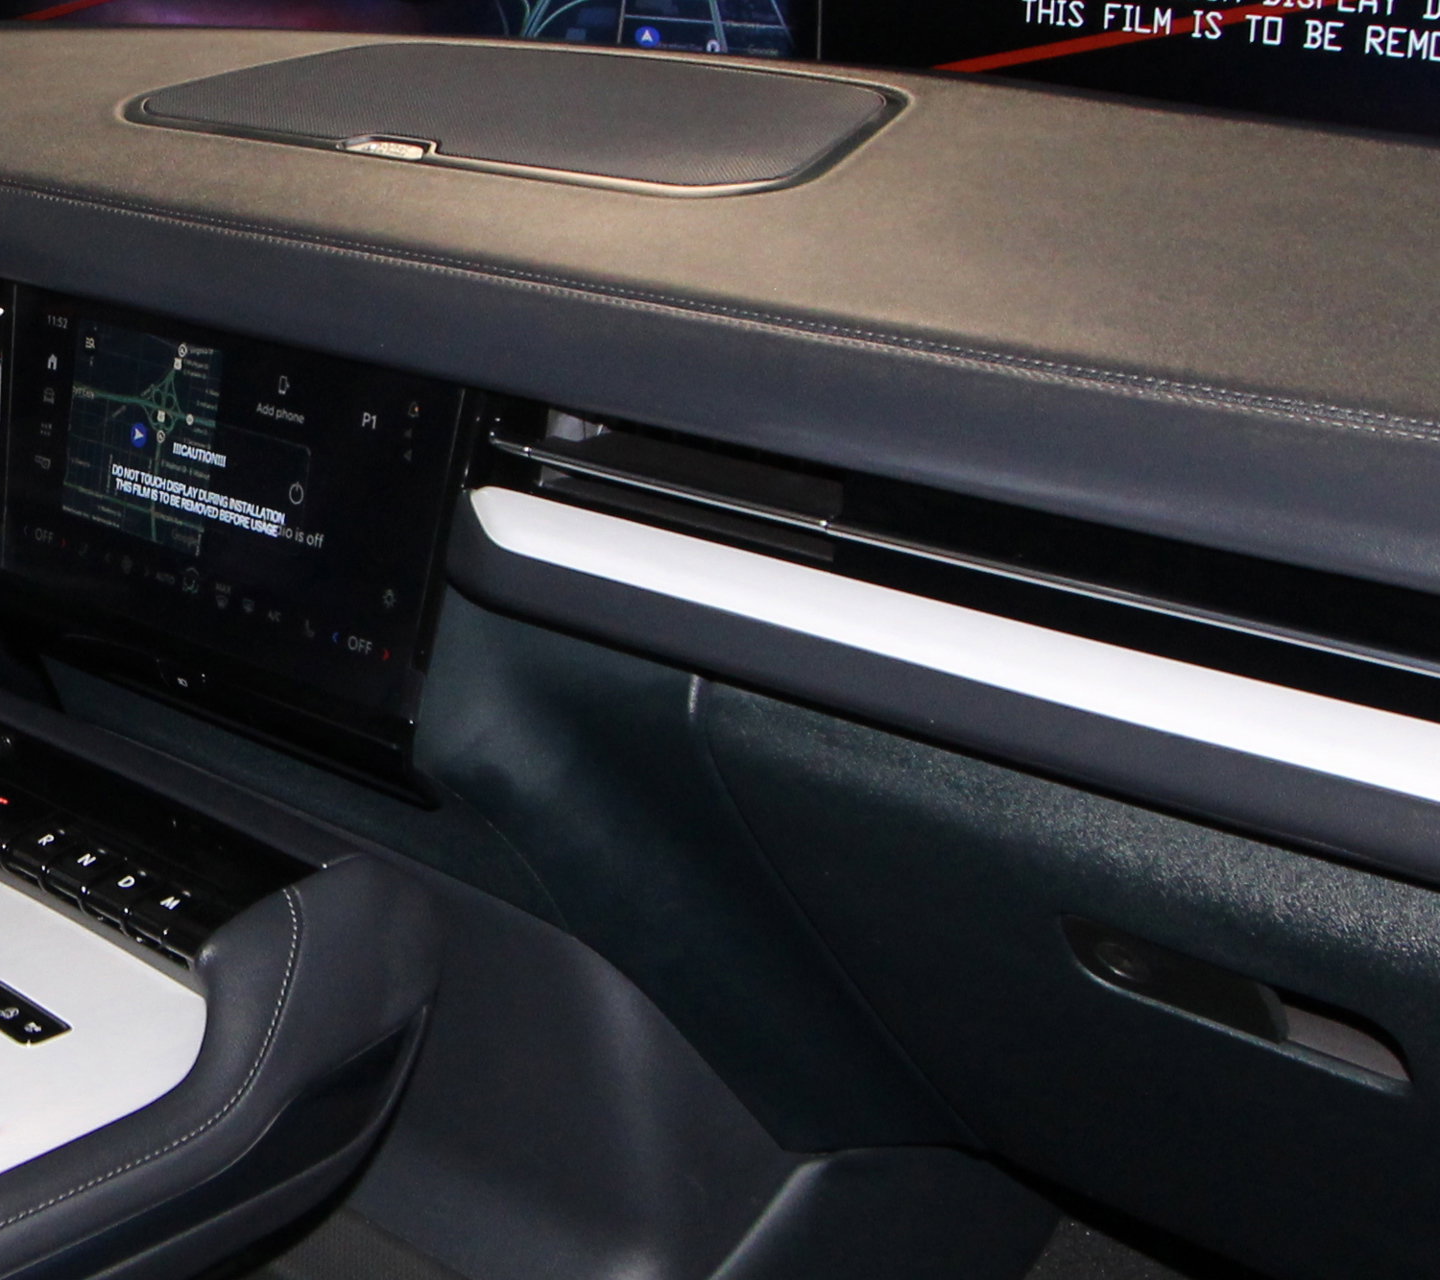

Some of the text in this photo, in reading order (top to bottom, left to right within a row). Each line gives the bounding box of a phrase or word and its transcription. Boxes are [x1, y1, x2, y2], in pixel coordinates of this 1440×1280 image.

[1103, 3, 1172, 36] FILM
[1191, 10, 1224, 40] IS
[1245, 14, 1282, 45] TO
[1303, 20, 1345, 52] BE
[256, 402, 305, 425] Add phone
[112, 464, 124, 478] DO
[124, 467, 140, 482] NOT
[140, 472, 167, 490] TOUCH
[166, 479, 199, 499] DISPLAY
[198, 489, 228, 509] DURING
[229, 497, 286, 525] INSTALLATION
[115, 477, 132, 493] THIS
[132, 482, 151, 499] FILM
[151, 488, 158, 502] IS
[159, 490, 170, 505] TO
[170, 494, 181, 509] BE
[181, 498, 219, 519] REMOVED
[219, 508, 251, 529] BEFORE
[250, 518, 279, 538] USAGE
[34, 527, 55, 544] OFF
[294, 526, 305, 543] is
[306, 532, 325, 549] off
[347, 634, 373, 656] OFF
[38, 834, 55, 847] R
[77, 853, 97, 867] N
[117, 875, 136, 888] D
